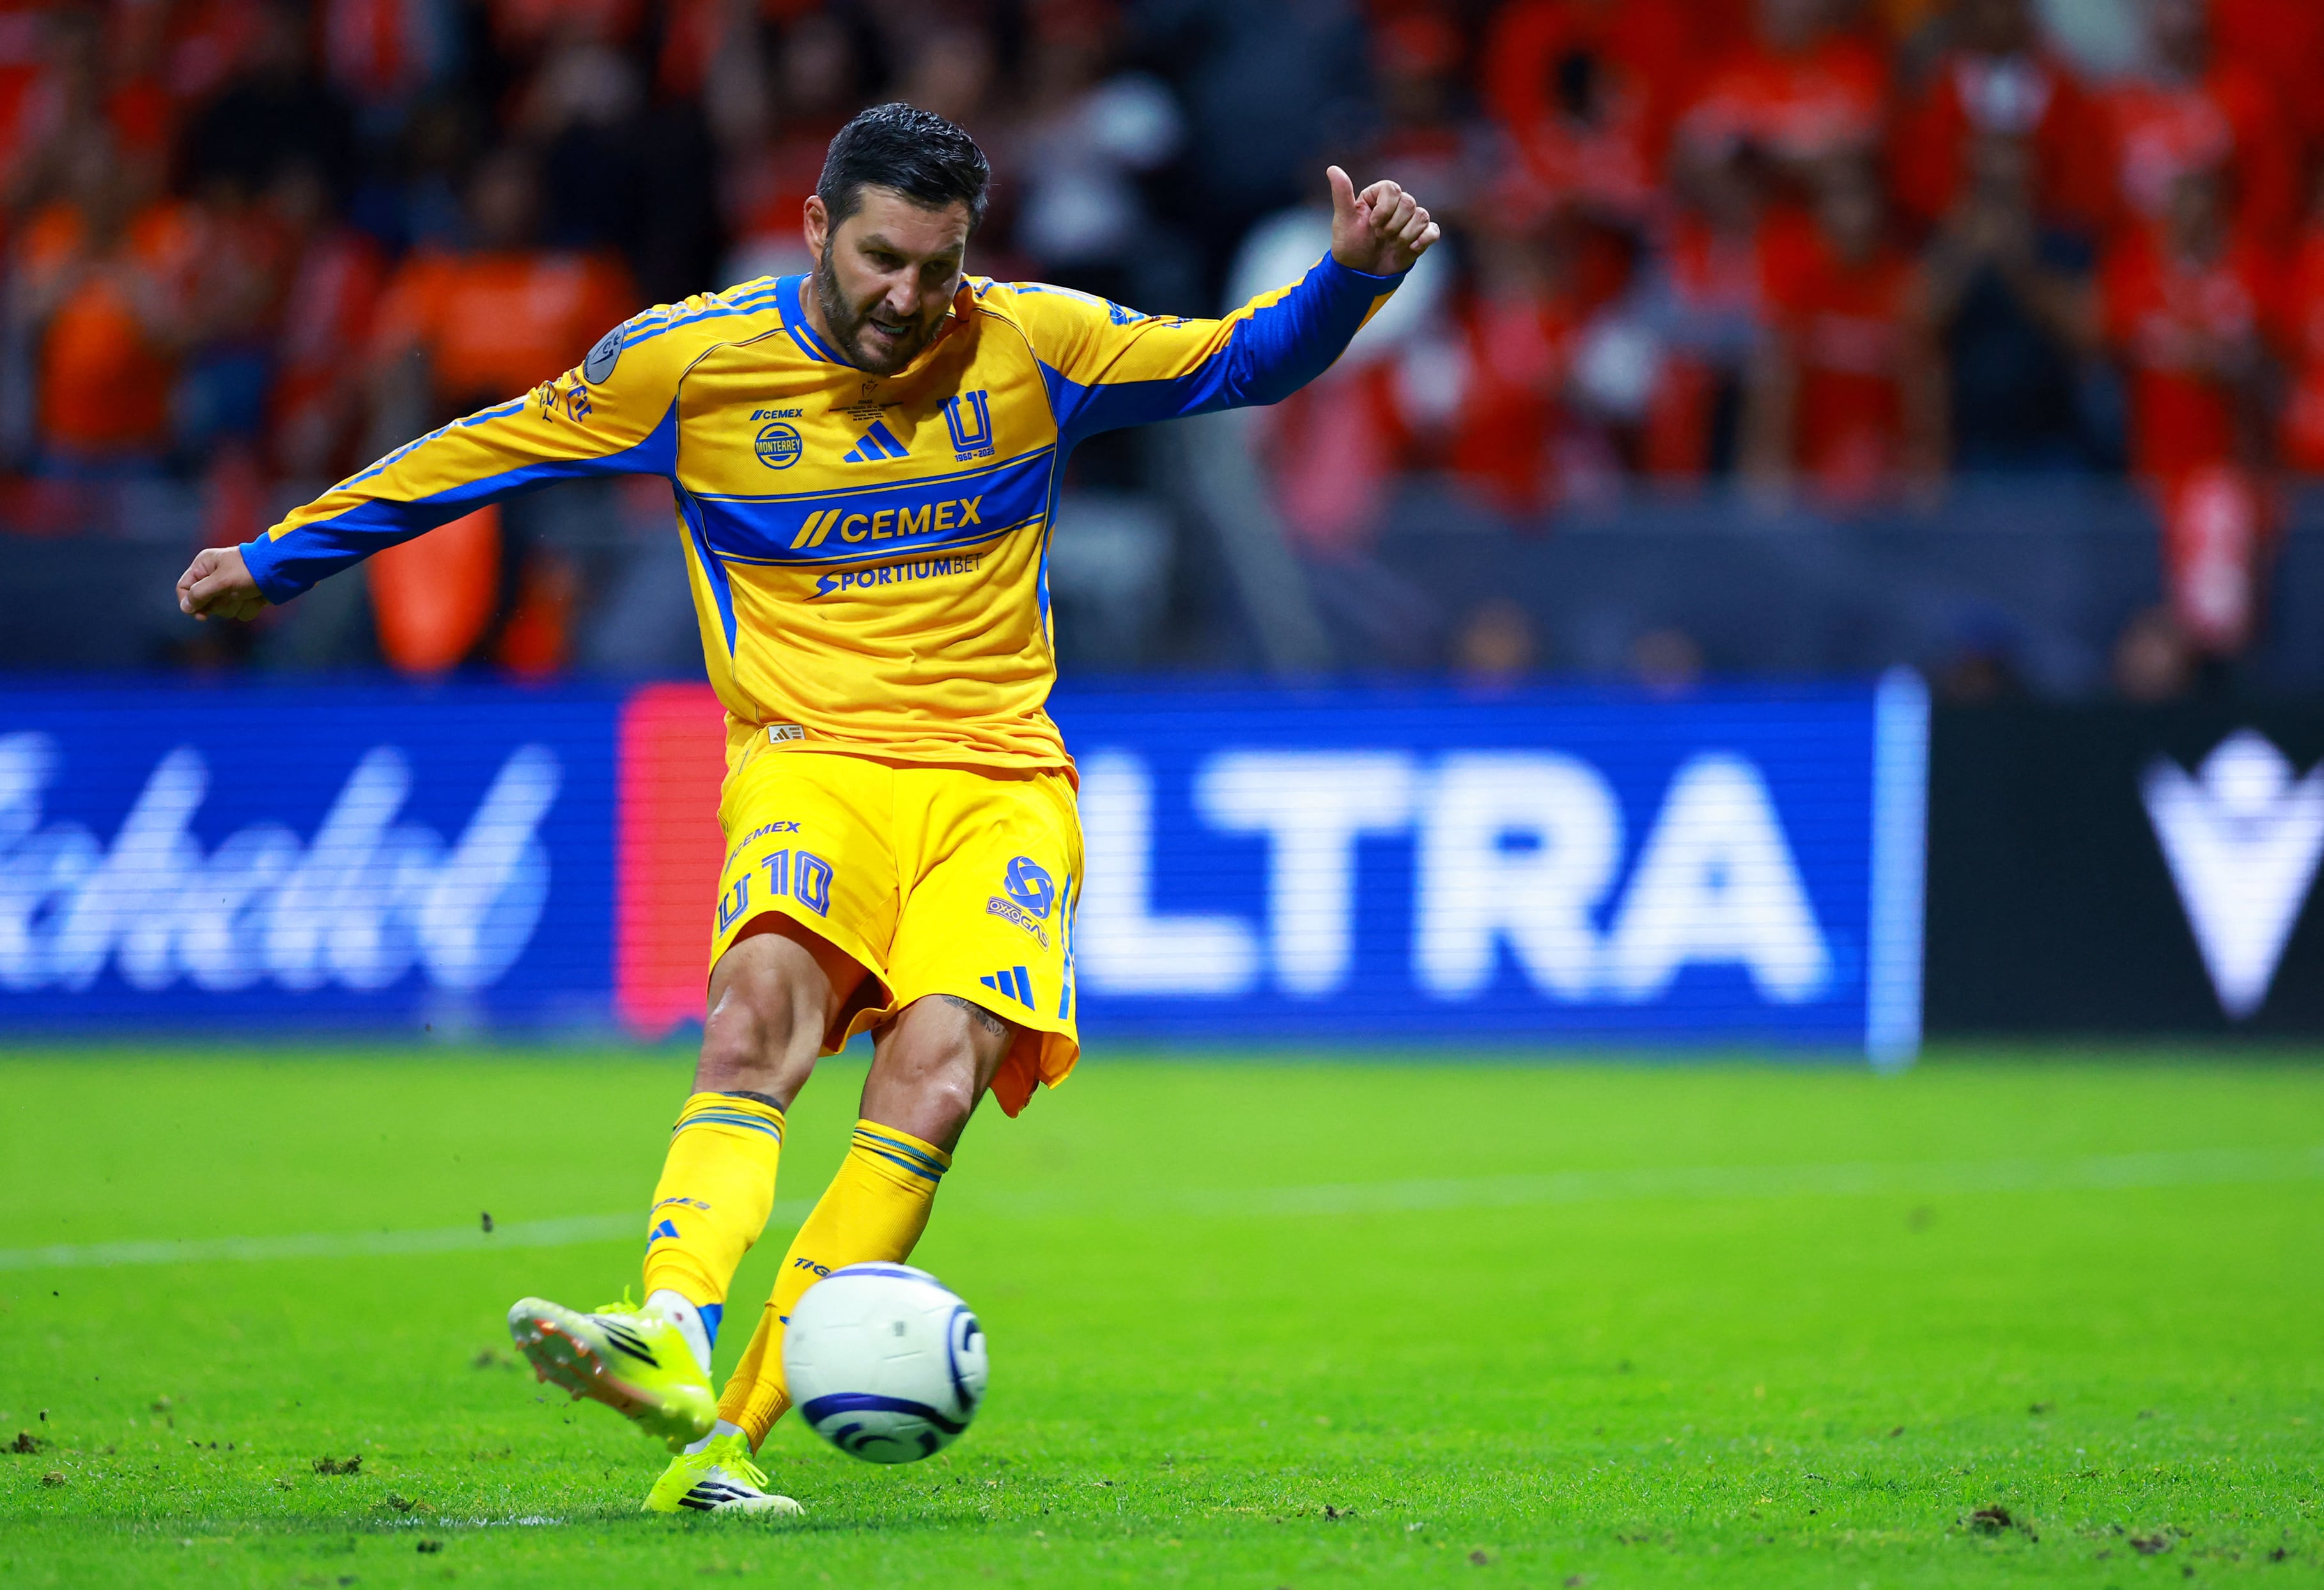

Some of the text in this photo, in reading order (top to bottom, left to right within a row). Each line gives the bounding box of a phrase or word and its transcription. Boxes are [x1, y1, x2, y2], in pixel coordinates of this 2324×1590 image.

[763, 409, 803, 419] CEMEX
[755, 438, 801, 453] MONTERREY
[840, 495, 983, 543] CEMEX
[802, 552, 983, 602] SPORTIUMBET
[761, 849, 833, 918] 10
[1080, 748, 1833, 1002] LTRA
[990, 902, 1048, 948] OXXO GAS
[794, 1258, 831, 1277] TIG
